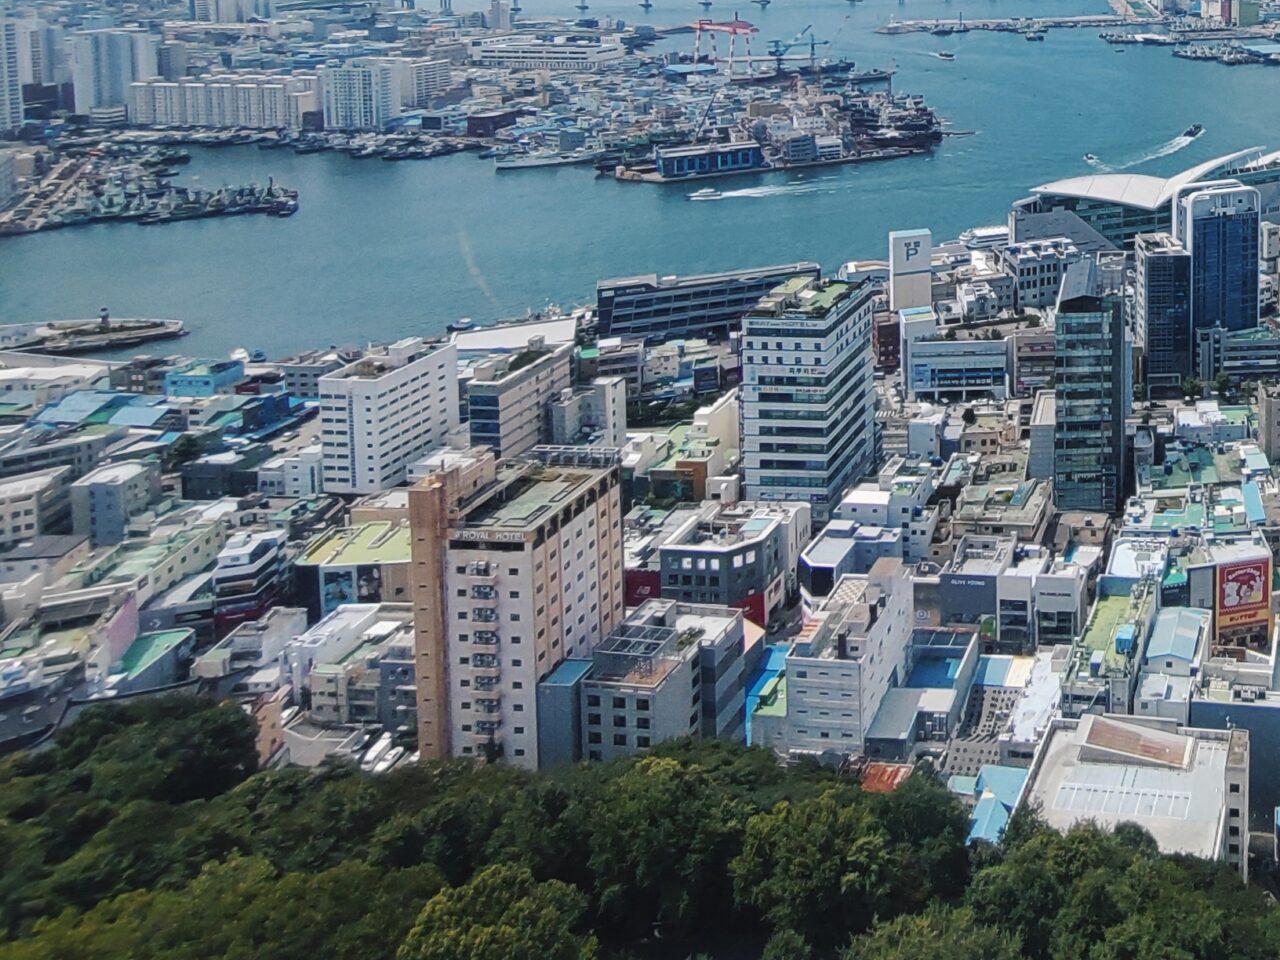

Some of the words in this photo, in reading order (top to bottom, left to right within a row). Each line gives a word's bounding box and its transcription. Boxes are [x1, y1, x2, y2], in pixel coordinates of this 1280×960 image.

[906, 247, 918, 261] P
[462, 531, 489, 539] ROYAL
[495, 531, 527, 541] HOTEL
